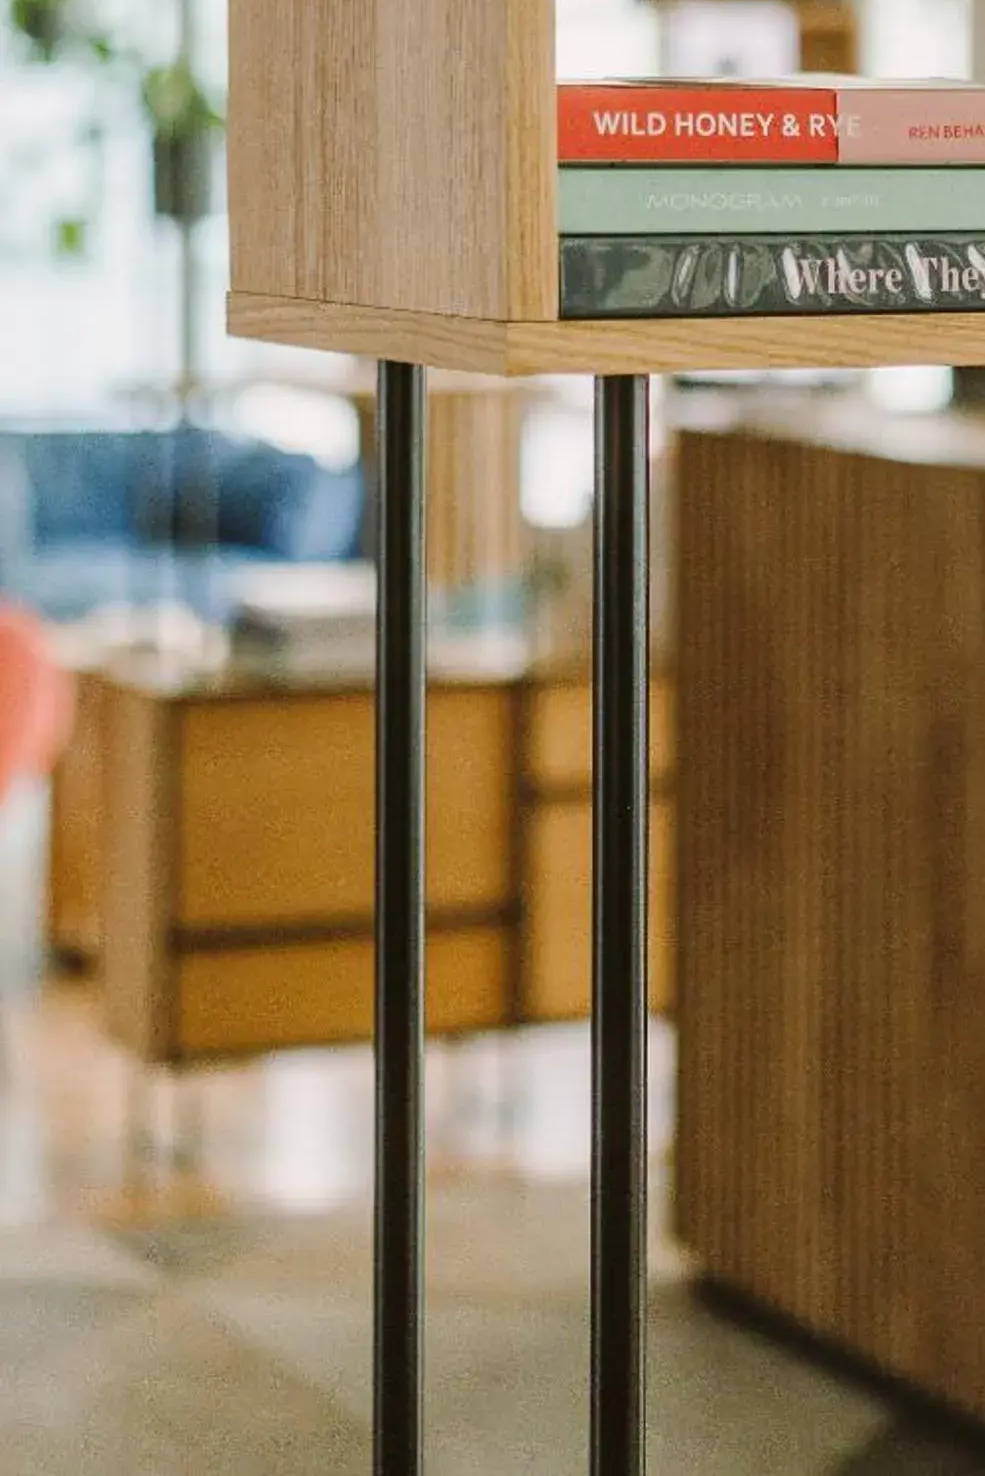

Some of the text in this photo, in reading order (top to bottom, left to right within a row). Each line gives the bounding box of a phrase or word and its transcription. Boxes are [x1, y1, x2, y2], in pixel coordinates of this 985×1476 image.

[593, 112, 862, 137] WILD HONEY & RYE
[908, 125, 941, 140] REN
[645, 192, 802, 211] MONOGRAM
[797, 257, 902, 296] Where
